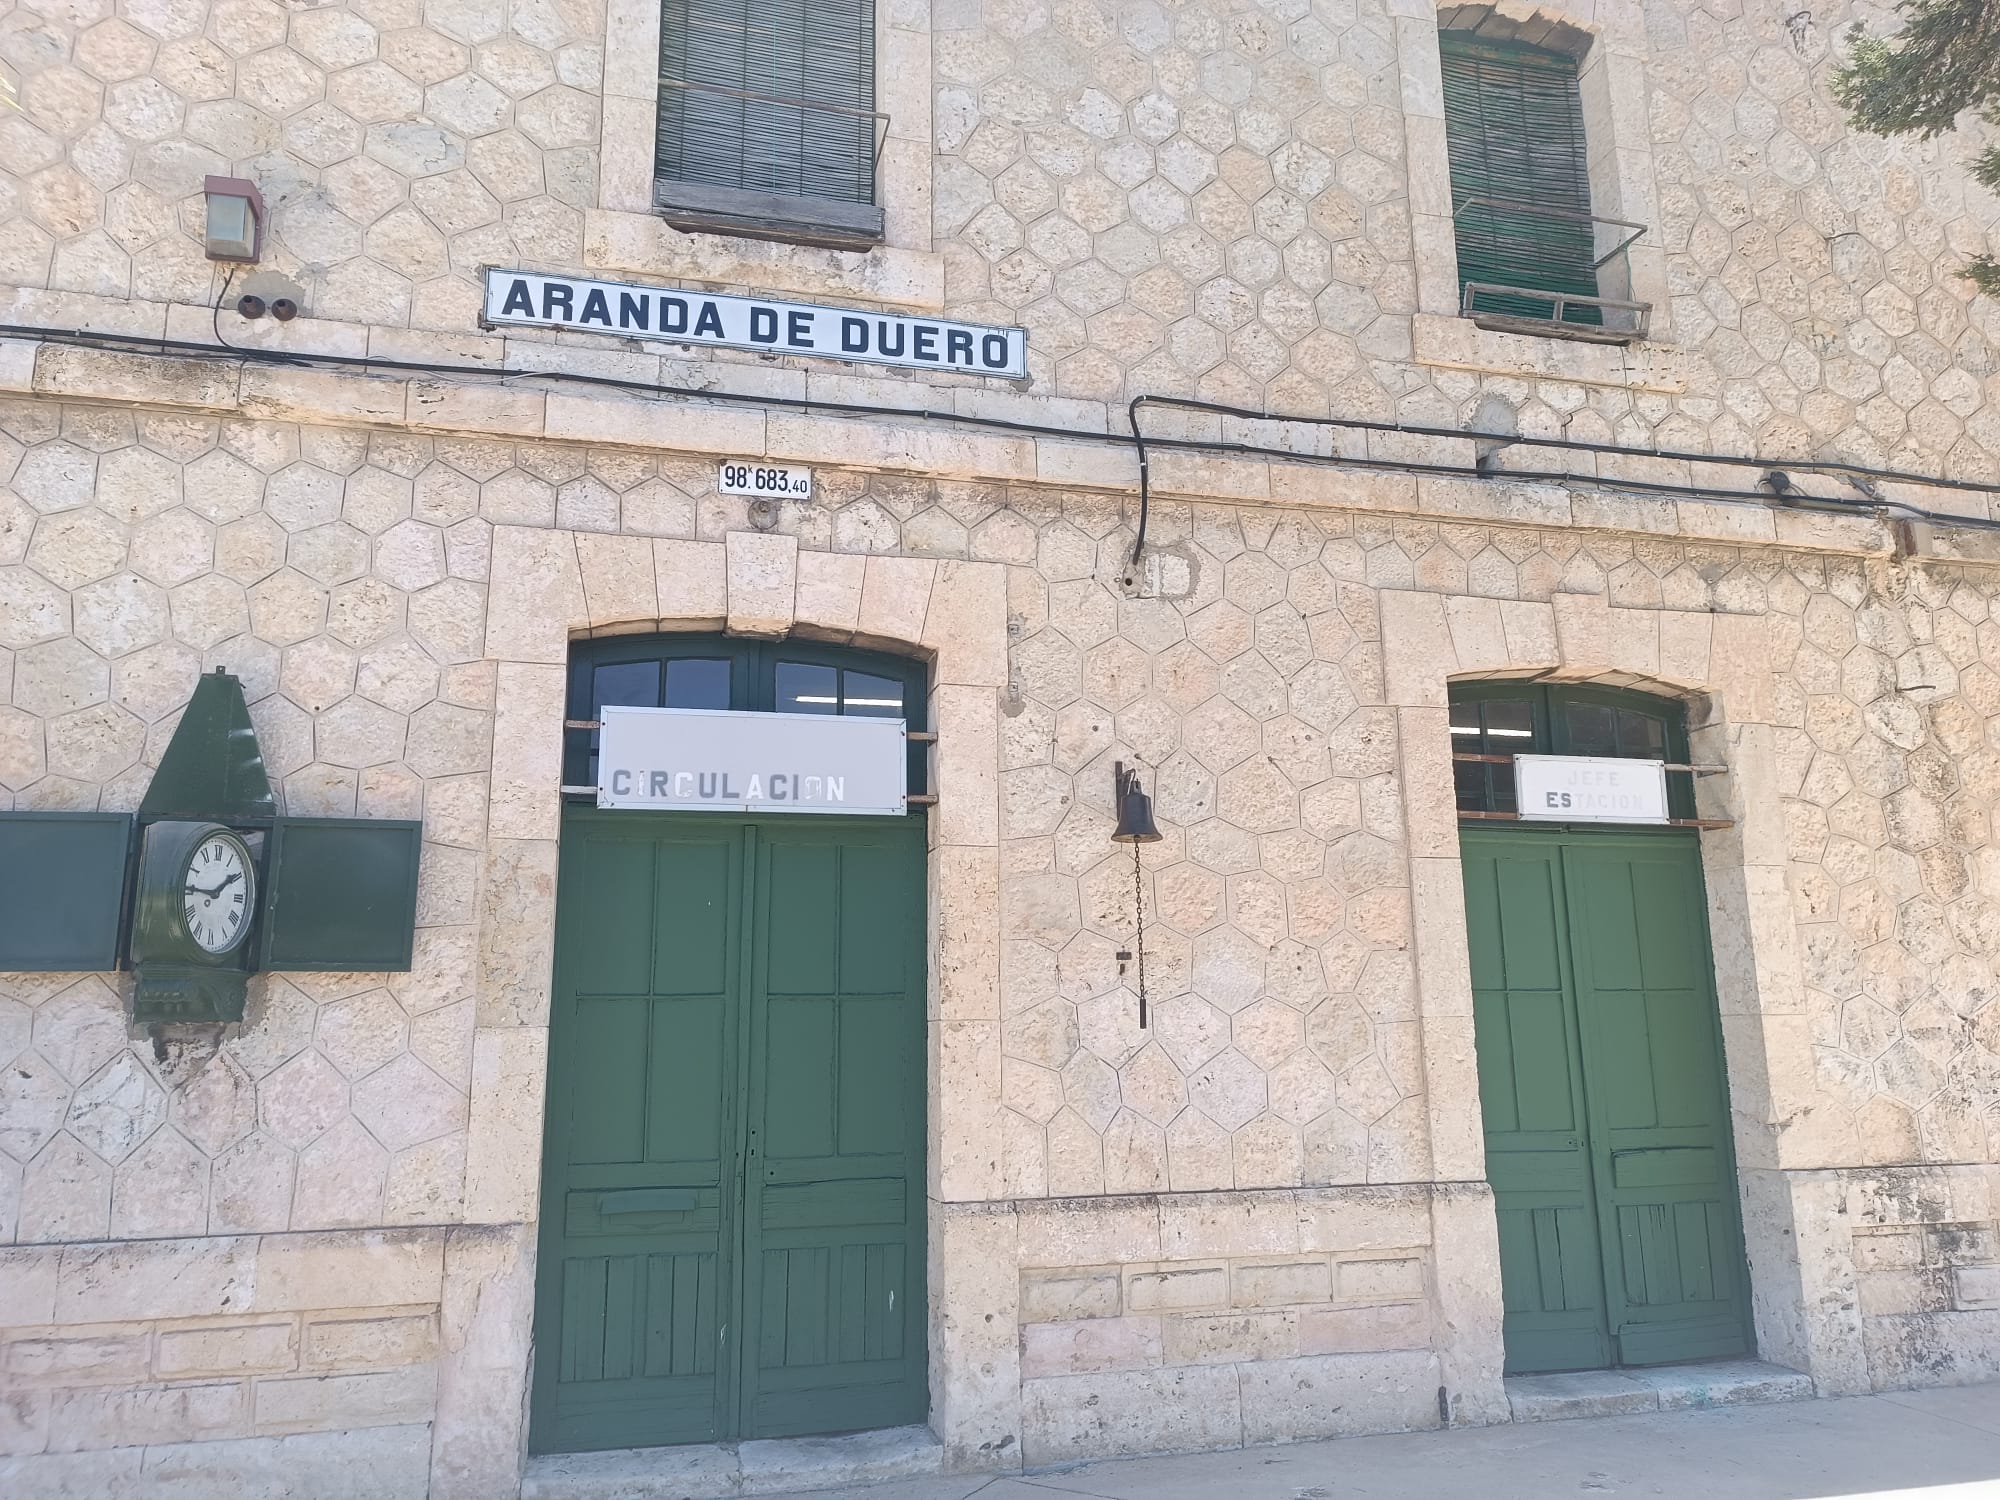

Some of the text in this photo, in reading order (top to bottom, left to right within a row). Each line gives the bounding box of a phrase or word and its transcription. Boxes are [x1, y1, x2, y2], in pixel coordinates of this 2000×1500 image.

[501, 279, 1009, 368] ARANDA DE DUERO
[612, 769, 846, 801] CIRCULACION
[1568, 770, 1620, 787] JEFE
[1545, 791, 1643, 811] ESTACION
